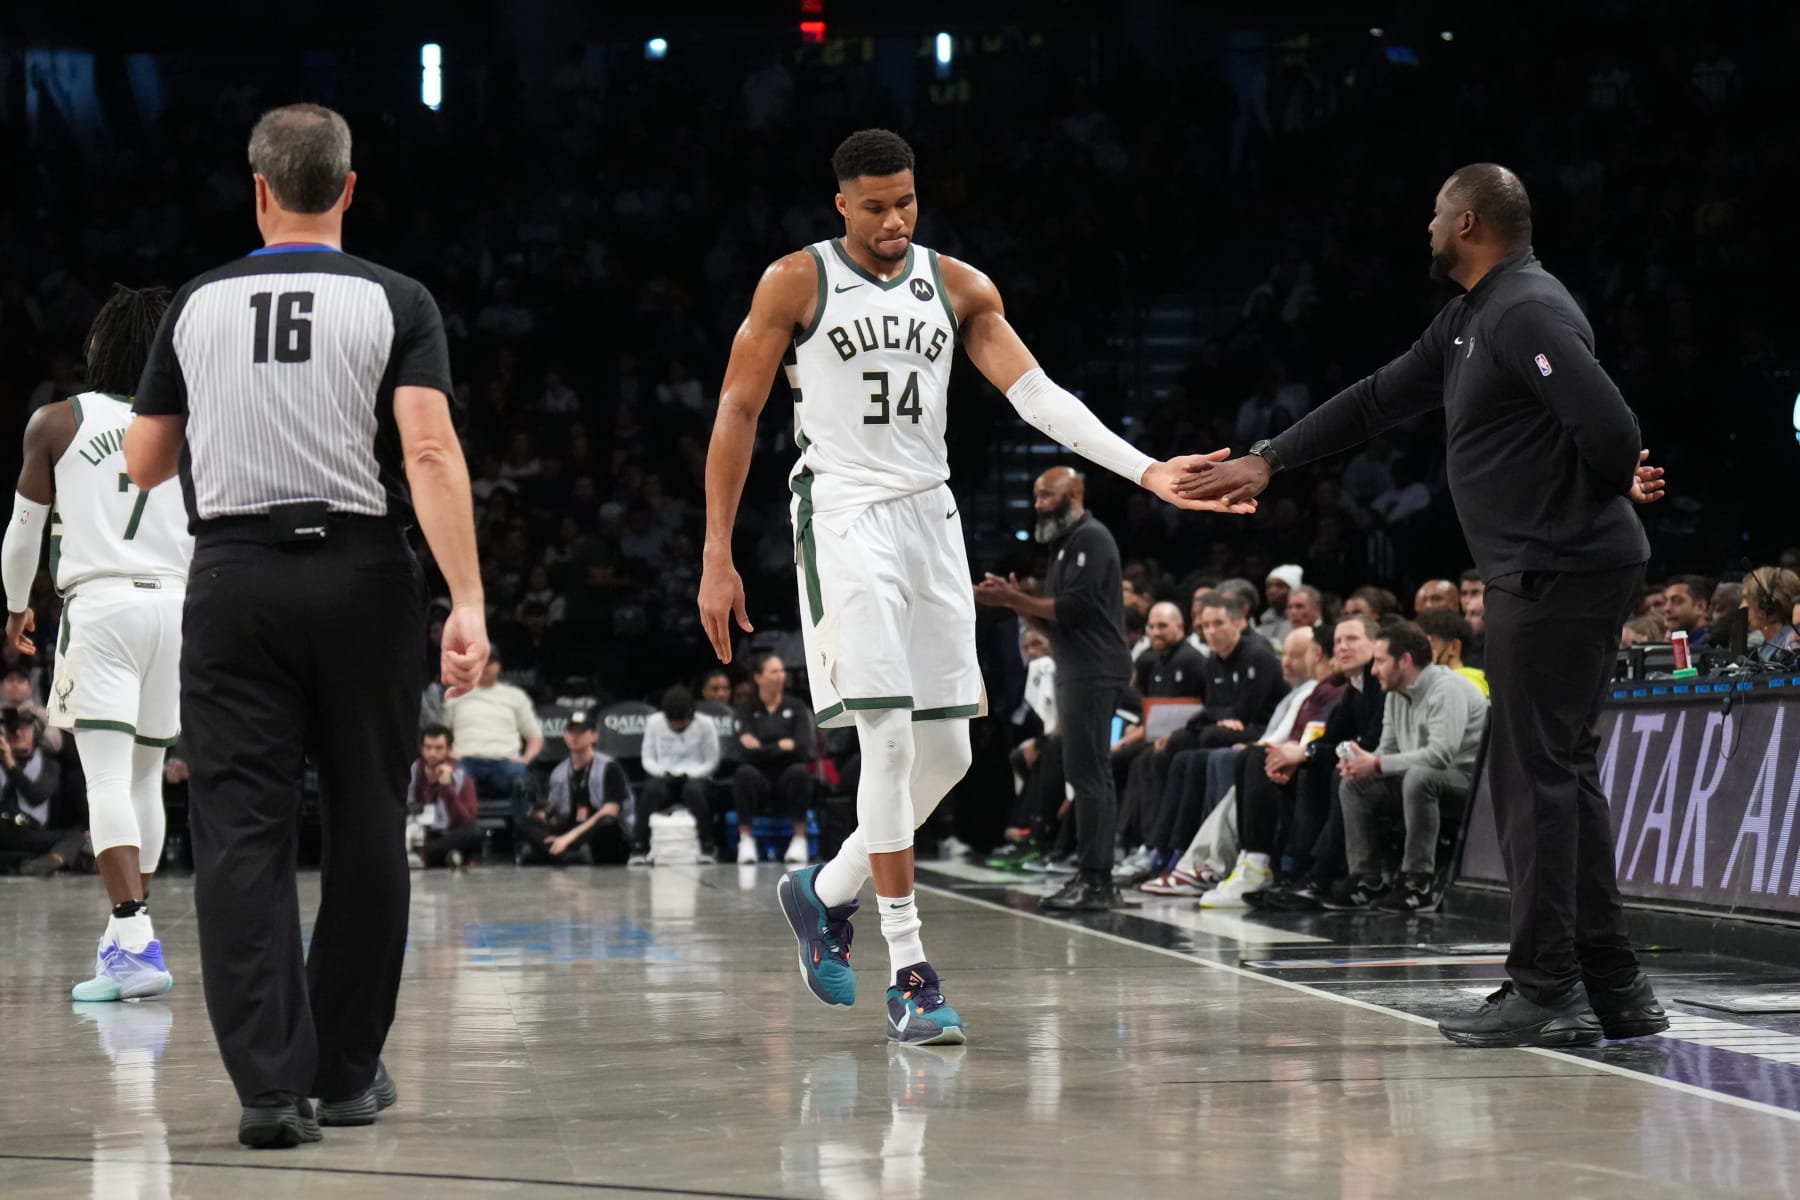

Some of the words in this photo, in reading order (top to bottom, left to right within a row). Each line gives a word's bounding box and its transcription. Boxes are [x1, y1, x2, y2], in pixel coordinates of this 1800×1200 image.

[250, 291, 314, 363] 16
[827, 315, 948, 362] BUCKS
[862, 371, 923, 425] 34
[118, 472, 150, 540] 7
[1720, 706, 1800, 897] AI
